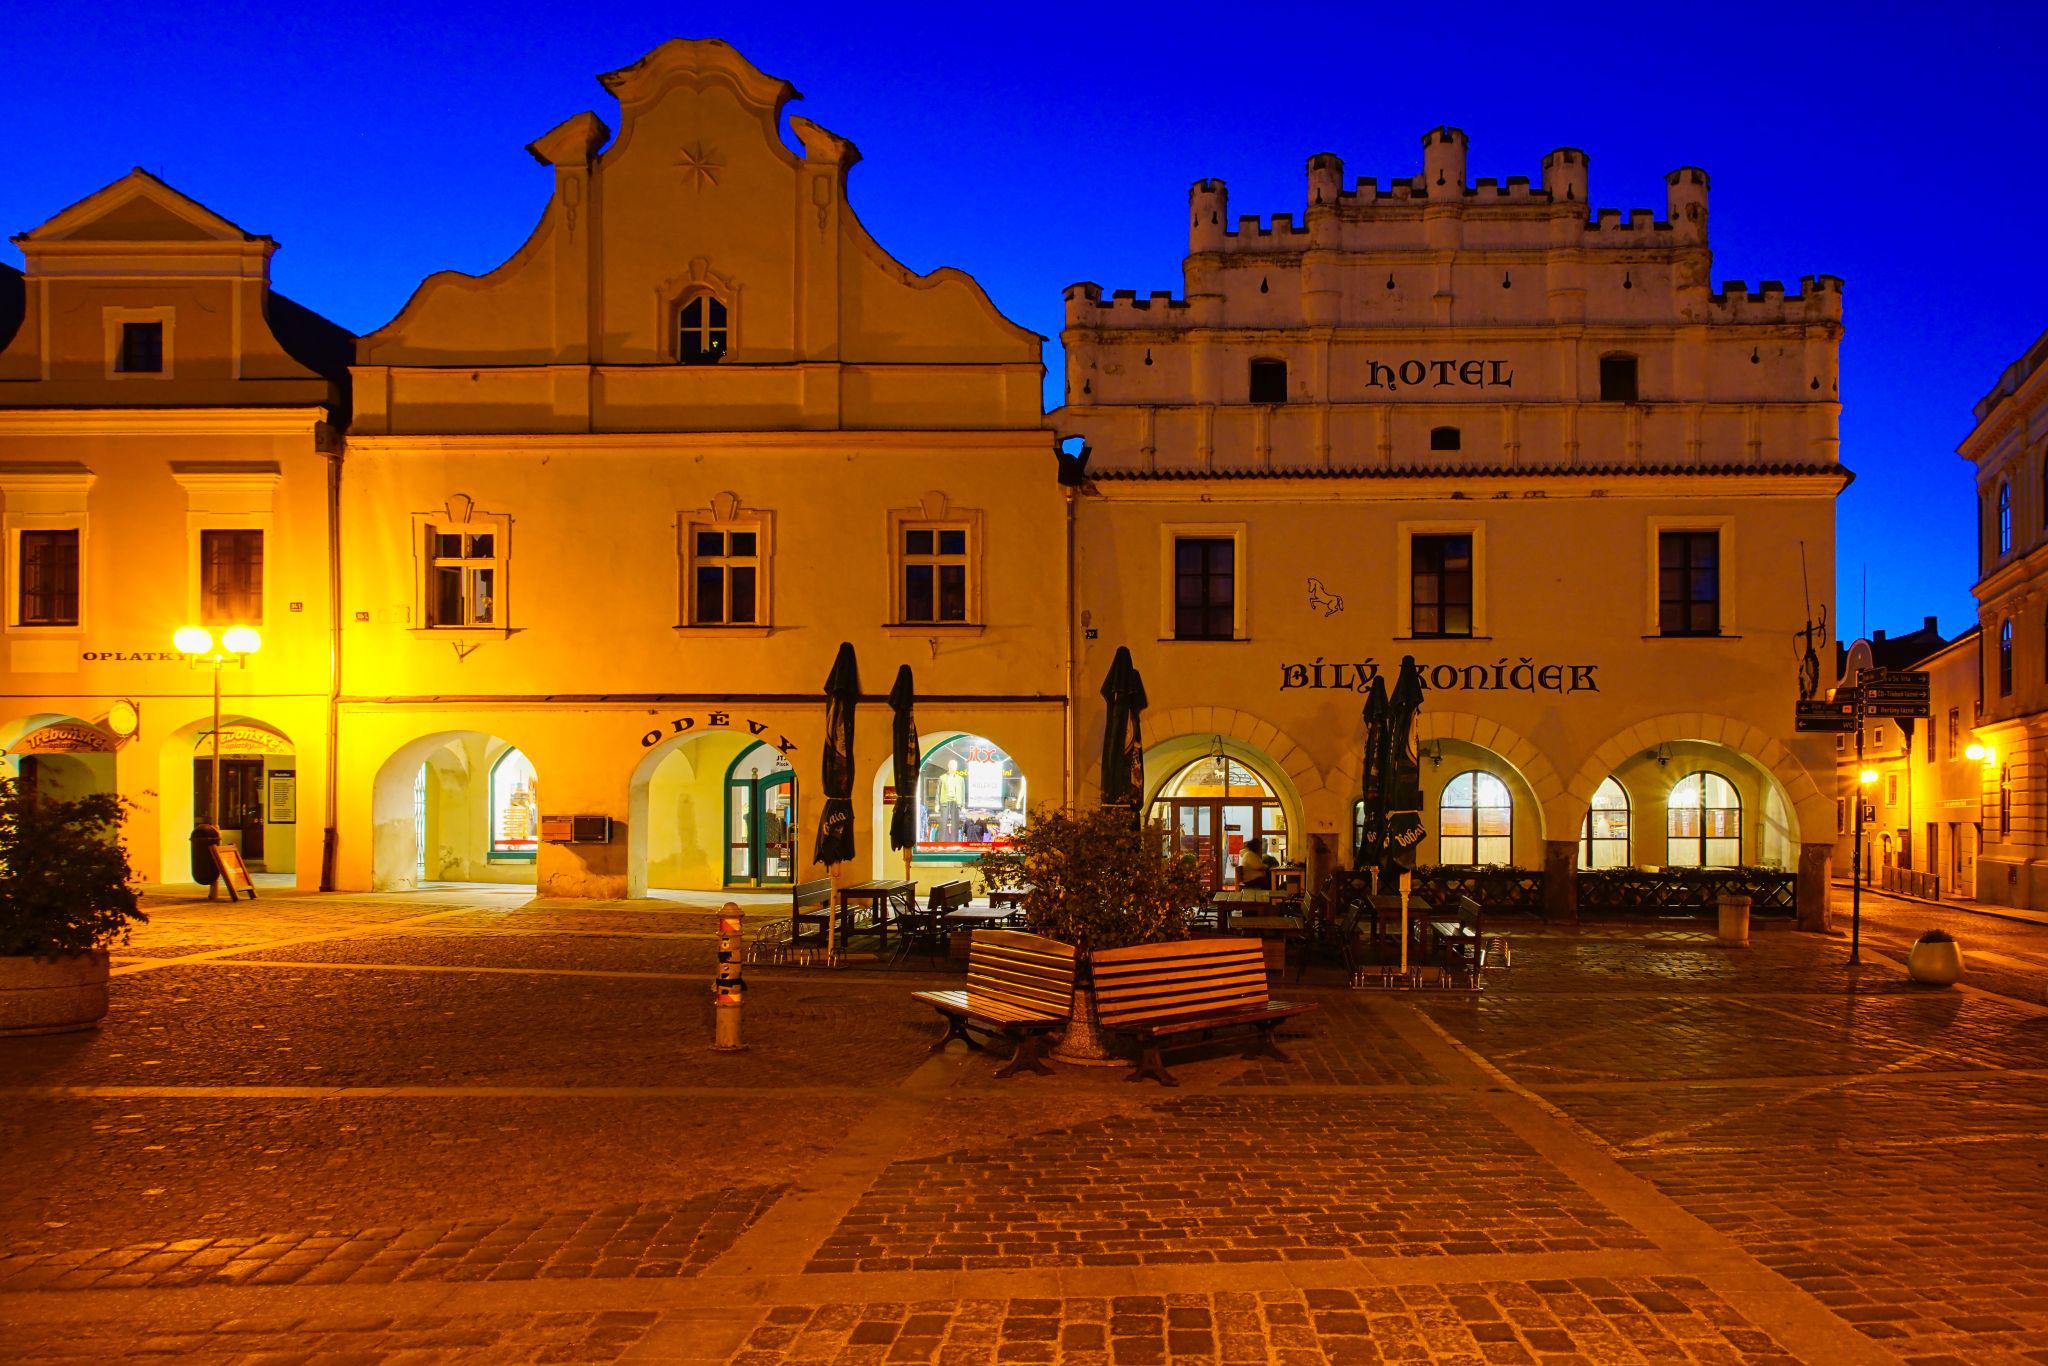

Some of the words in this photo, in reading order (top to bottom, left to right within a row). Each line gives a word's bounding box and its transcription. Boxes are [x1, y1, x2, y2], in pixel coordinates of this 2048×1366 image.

[1365, 359, 1514, 391] HOTEL
[82, 651, 188, 661] OPLATKY
[1279, 656, 1380, 694] BÍLÝ
[206, 728, 282, 749] eboňské
[641, 710, 798, 755] ODĚVY
[1867, 807, 1873, 816] P
